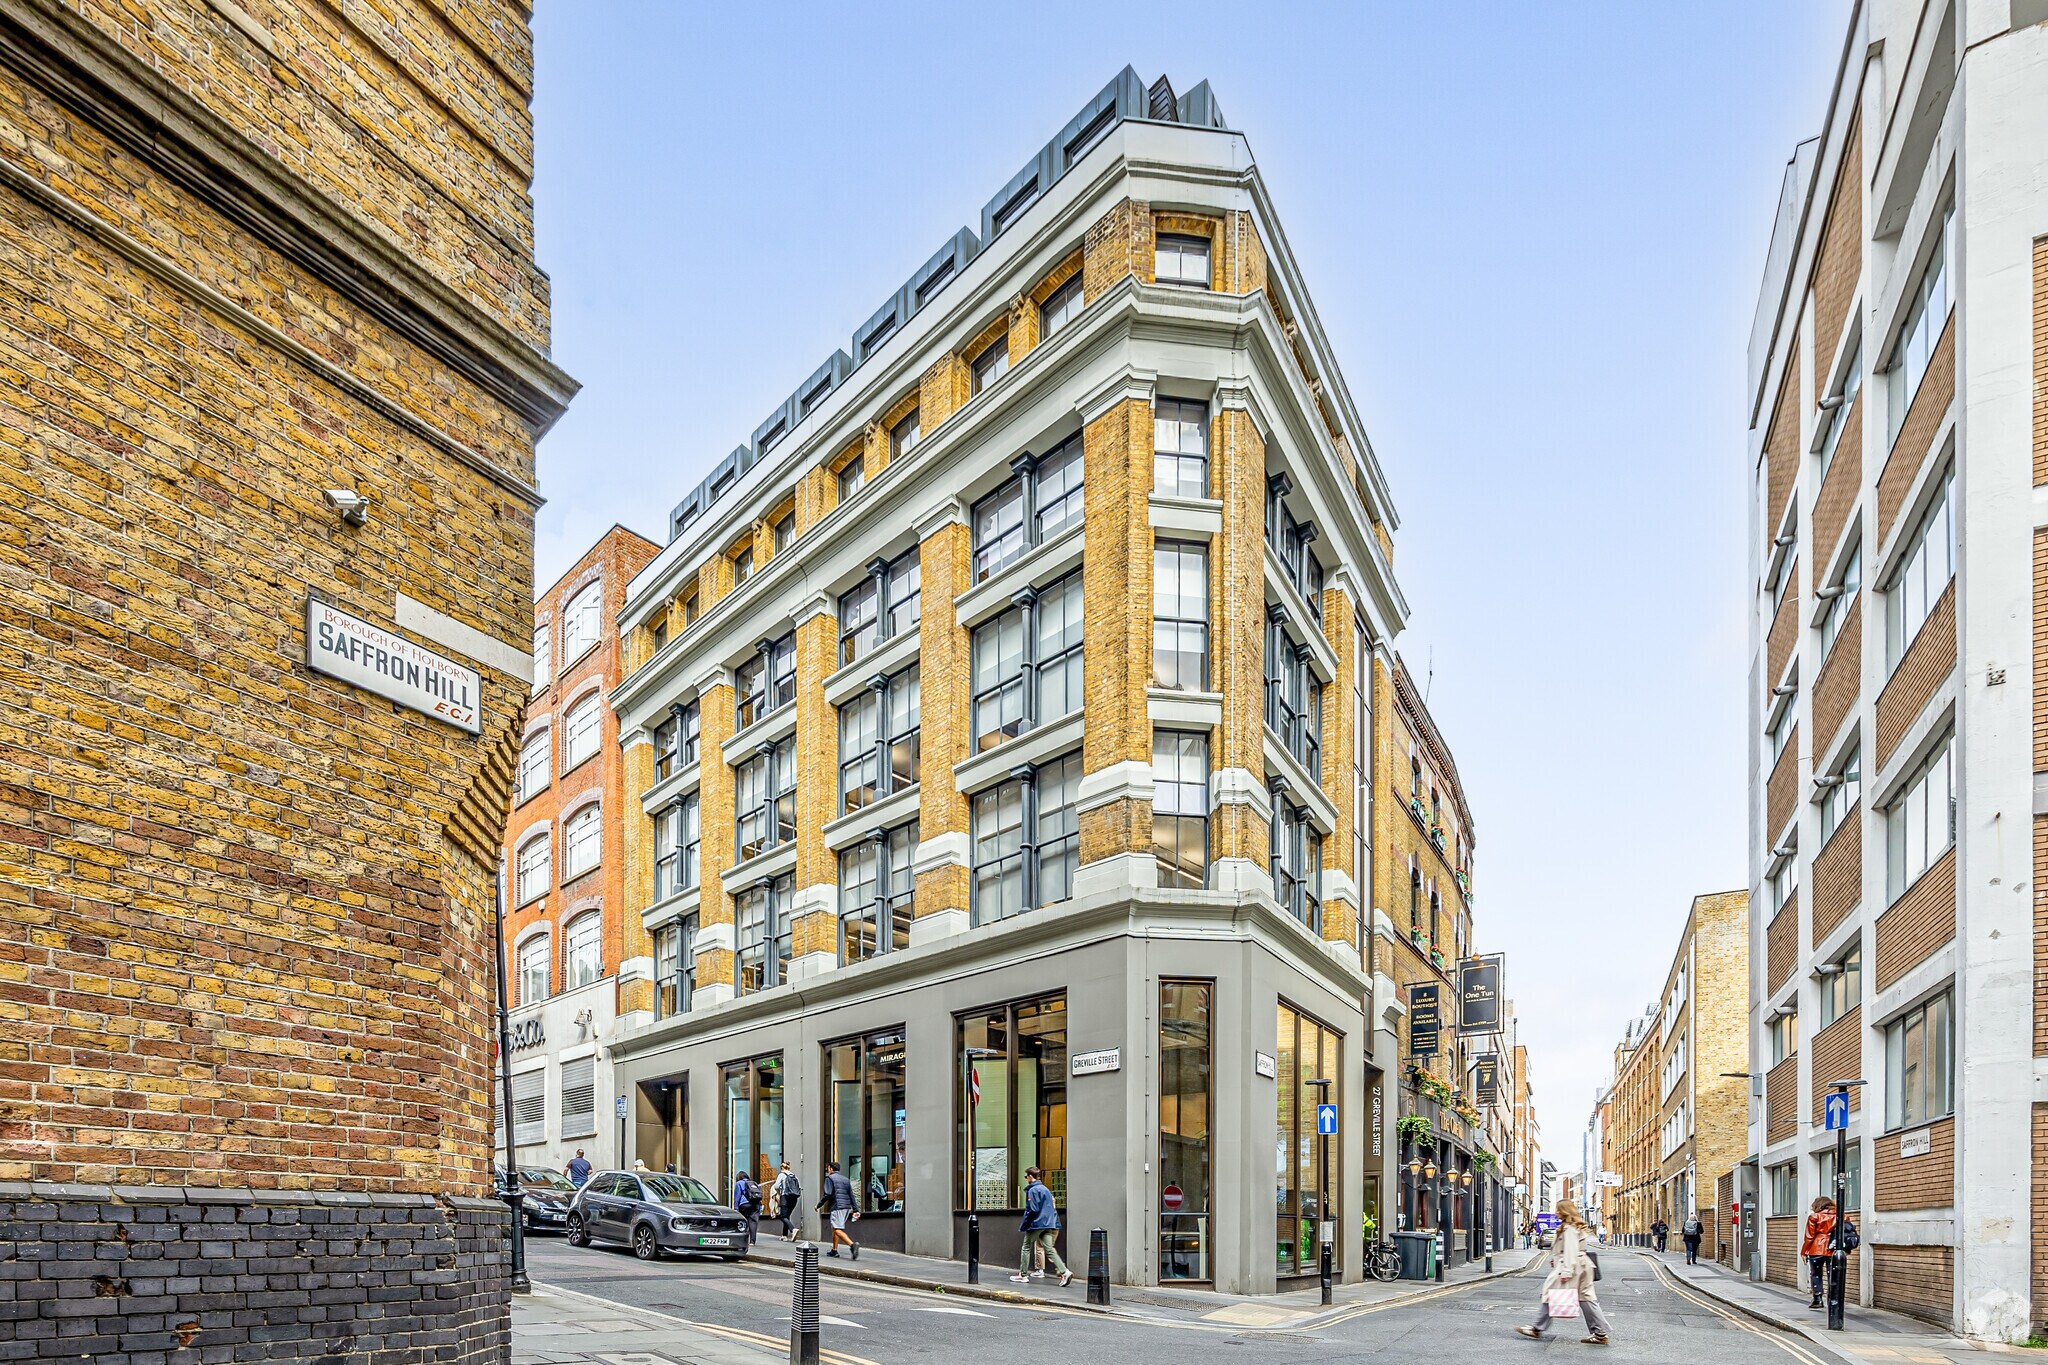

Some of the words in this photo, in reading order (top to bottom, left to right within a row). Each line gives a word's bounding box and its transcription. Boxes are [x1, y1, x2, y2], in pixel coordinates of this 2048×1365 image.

[324, 609, 388, 647] BOROUGH
[391, 641, 409, 655] OF
[413, 648, 470, 683] HOLBORN
[319, 621, 420, 689] SAFFRON
[425, 667, 474, 711] HILL
[1074, 1058, 1097, 1068] GREVILLE
[1098, 1054, 1117, 1065] STREET
[1372, 1086, 1381, 1096] 27
[1372, 1097, 1381, 1132] GREVILLE
[1372, 1132, 1381, 1156] STREET
